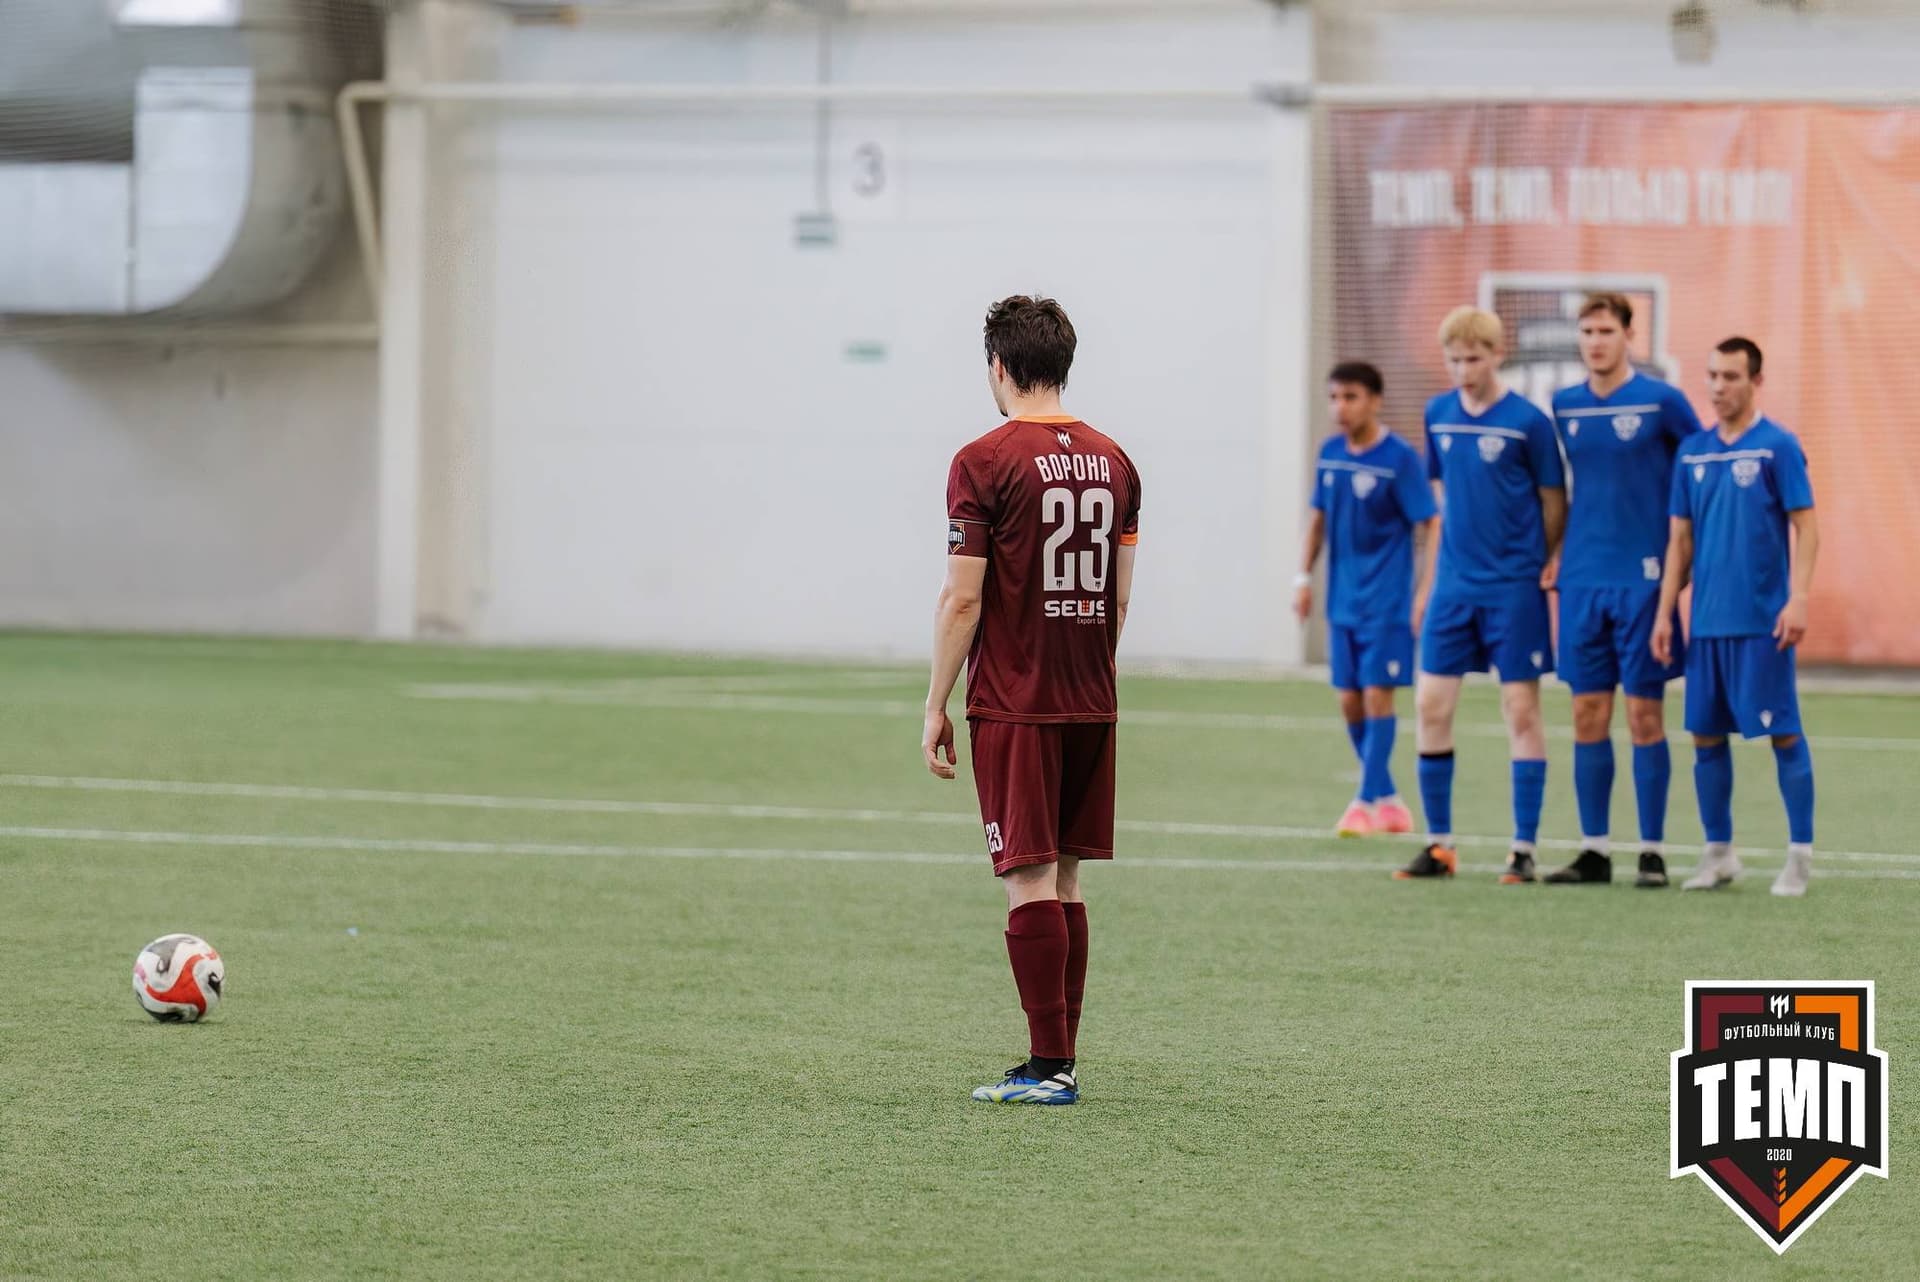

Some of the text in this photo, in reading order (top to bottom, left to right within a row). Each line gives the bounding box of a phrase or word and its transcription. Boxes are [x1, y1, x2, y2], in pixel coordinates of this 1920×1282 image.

[852, 141, 886, 198] 3
[1034, 454, 1111, 483] ВОРОНА
[1042, 487, 1114, 592] 23
[985, 821, 1004, 854] 23
